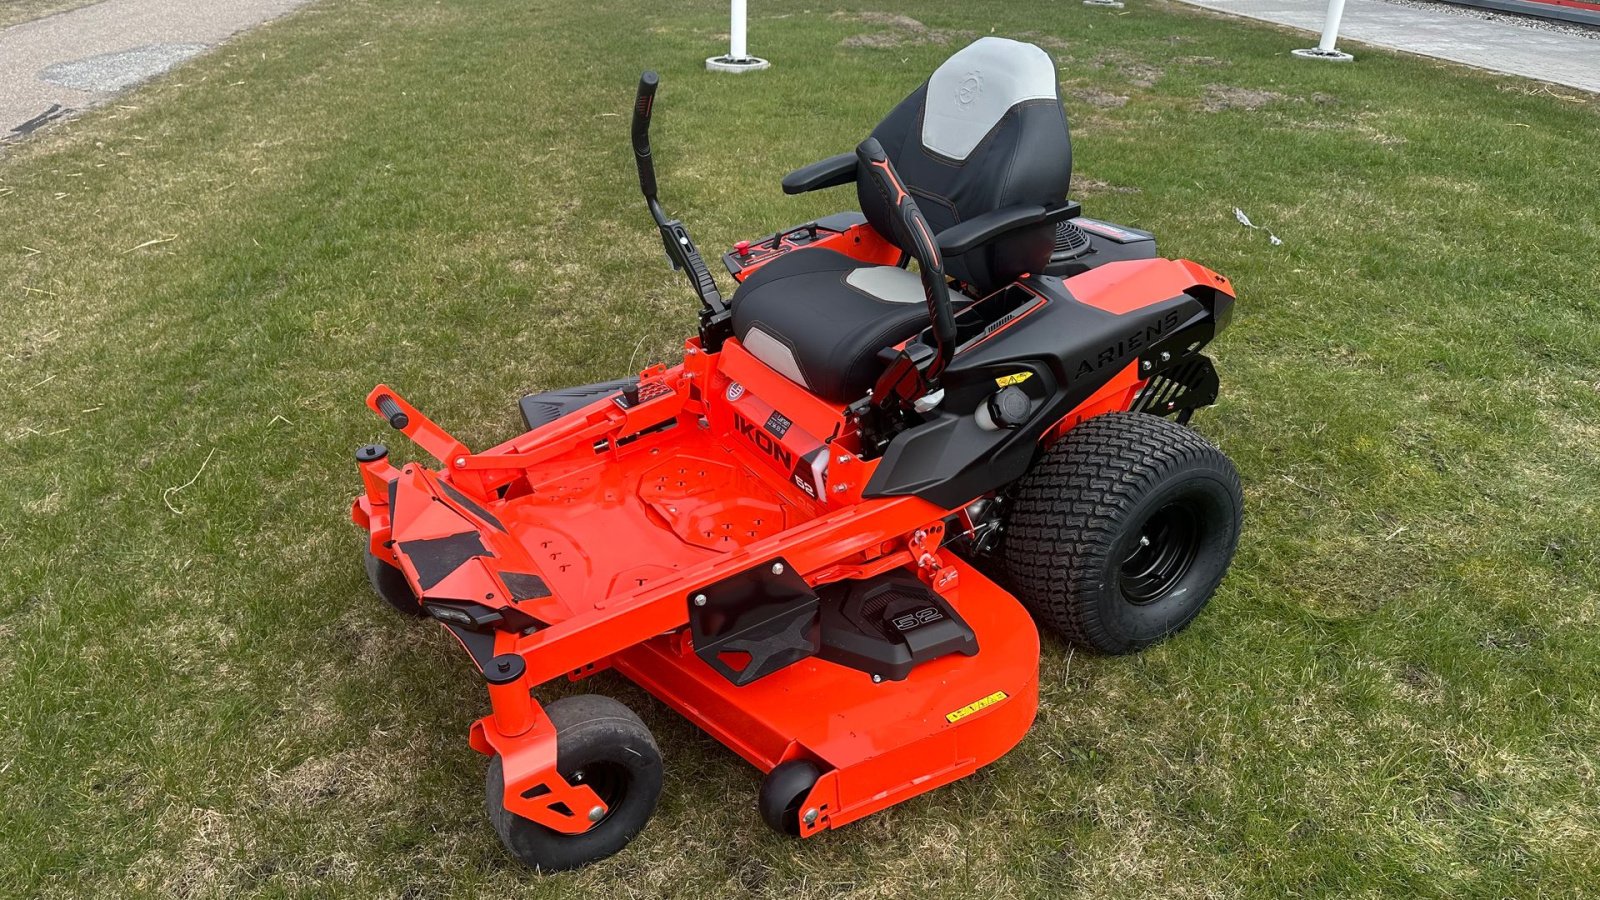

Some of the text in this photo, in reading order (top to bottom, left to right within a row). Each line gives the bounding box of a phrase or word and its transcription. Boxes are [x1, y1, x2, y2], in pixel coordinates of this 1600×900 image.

[1075, 310, 1178, 379] ARIENS
[733, 412, 792, 470] IKON
[794, 475, 814, 497] 52
[892, 607, 943, 630] 52
